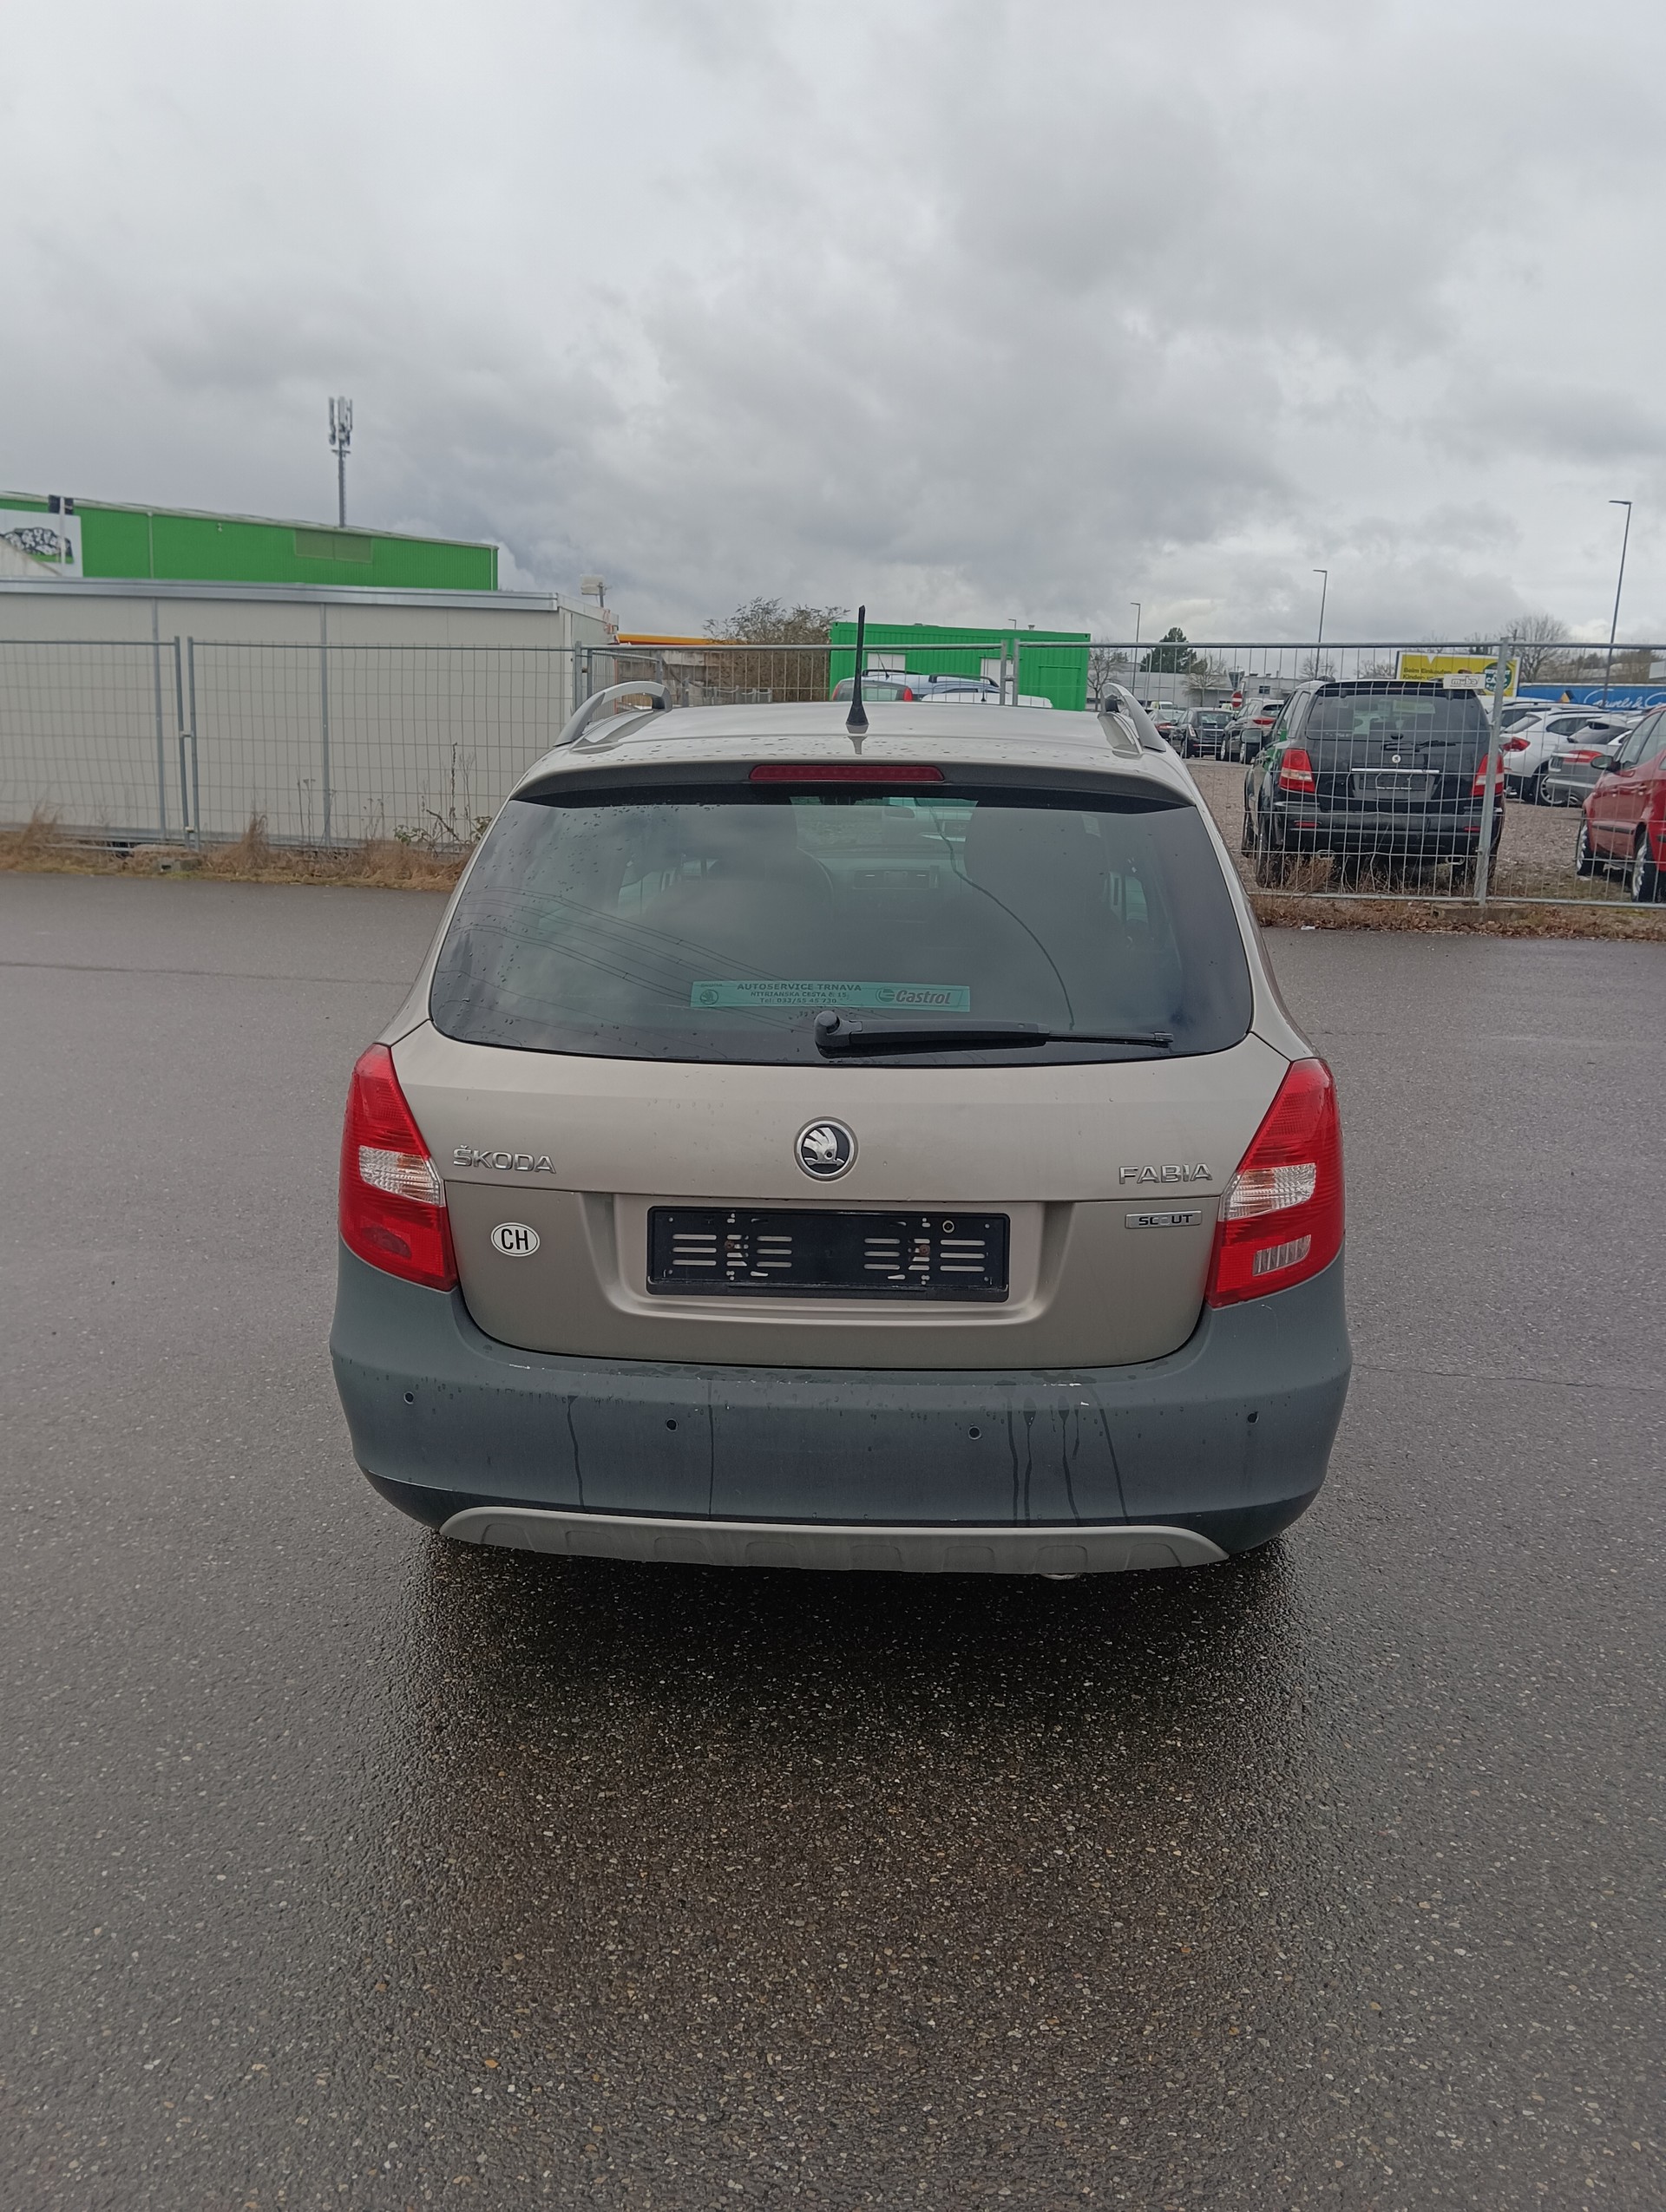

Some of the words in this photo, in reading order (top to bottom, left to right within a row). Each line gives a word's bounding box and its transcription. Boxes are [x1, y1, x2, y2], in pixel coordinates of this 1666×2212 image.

[895, 990, 952, 1005] Castrol
[453, 1144, 556, 1174] ŠKODA
[1119, 1163, 1212, 1184] FABIA
[501, 1228, 529, 1250] CH
